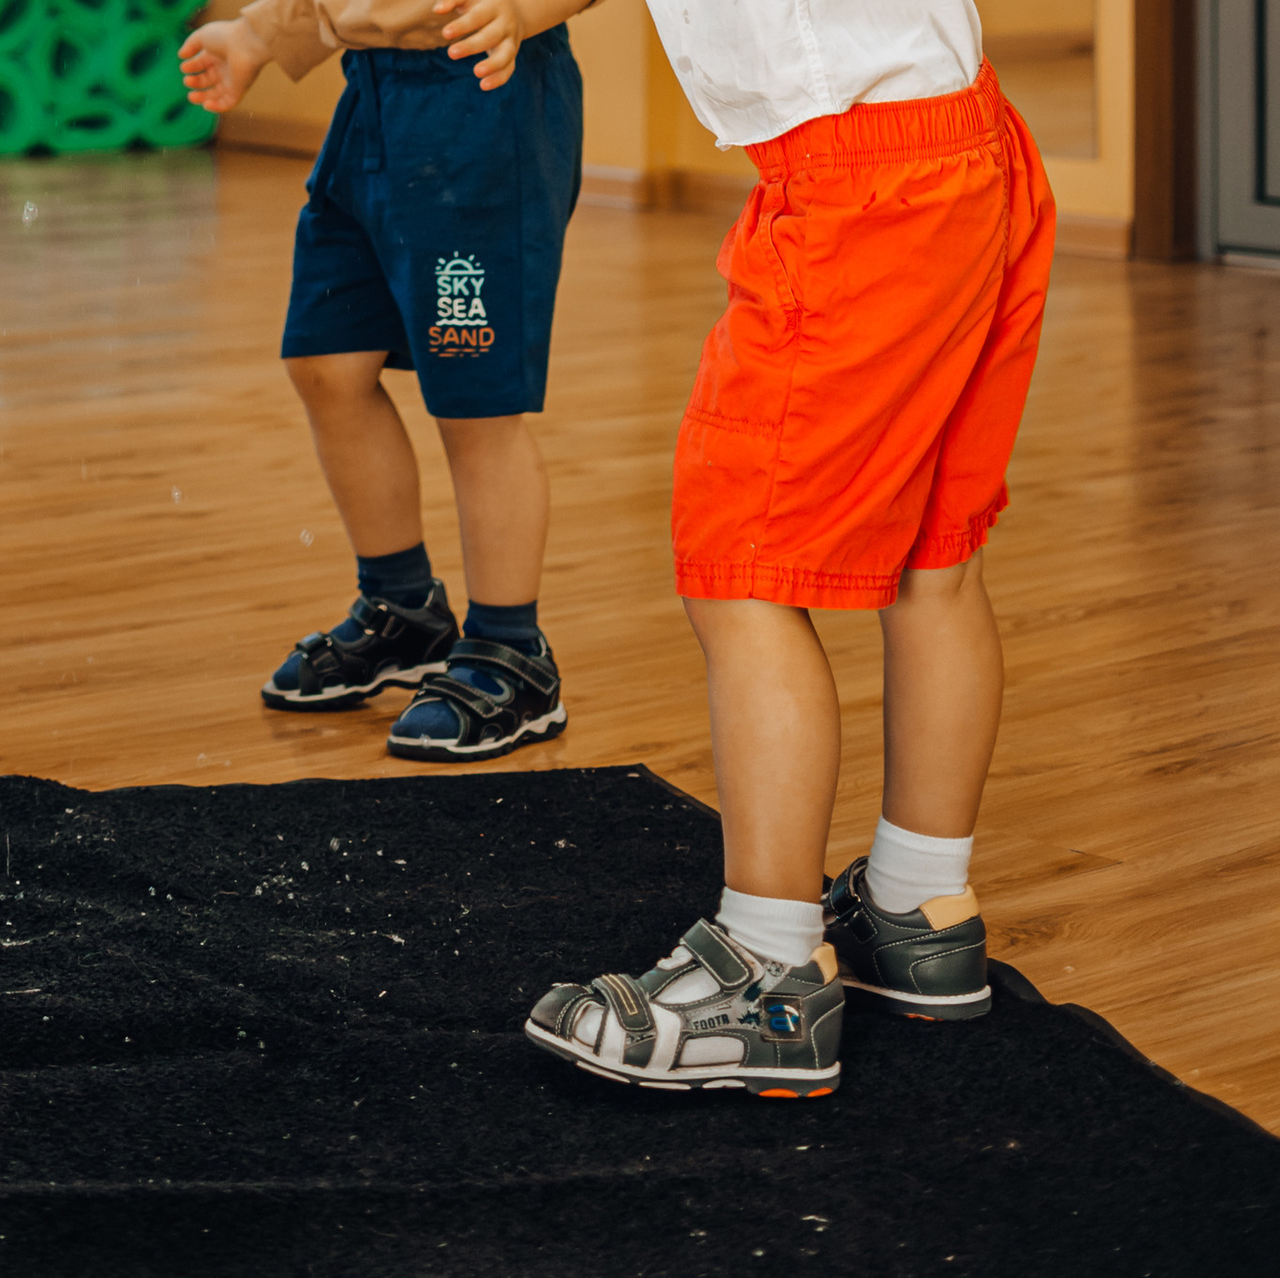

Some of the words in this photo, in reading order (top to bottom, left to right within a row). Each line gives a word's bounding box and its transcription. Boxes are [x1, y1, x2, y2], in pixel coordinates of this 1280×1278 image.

[436, 275, 485, 296] SKY
[436, 296, 487, 318] SEA
[428, 326, 495, 346] SAND
